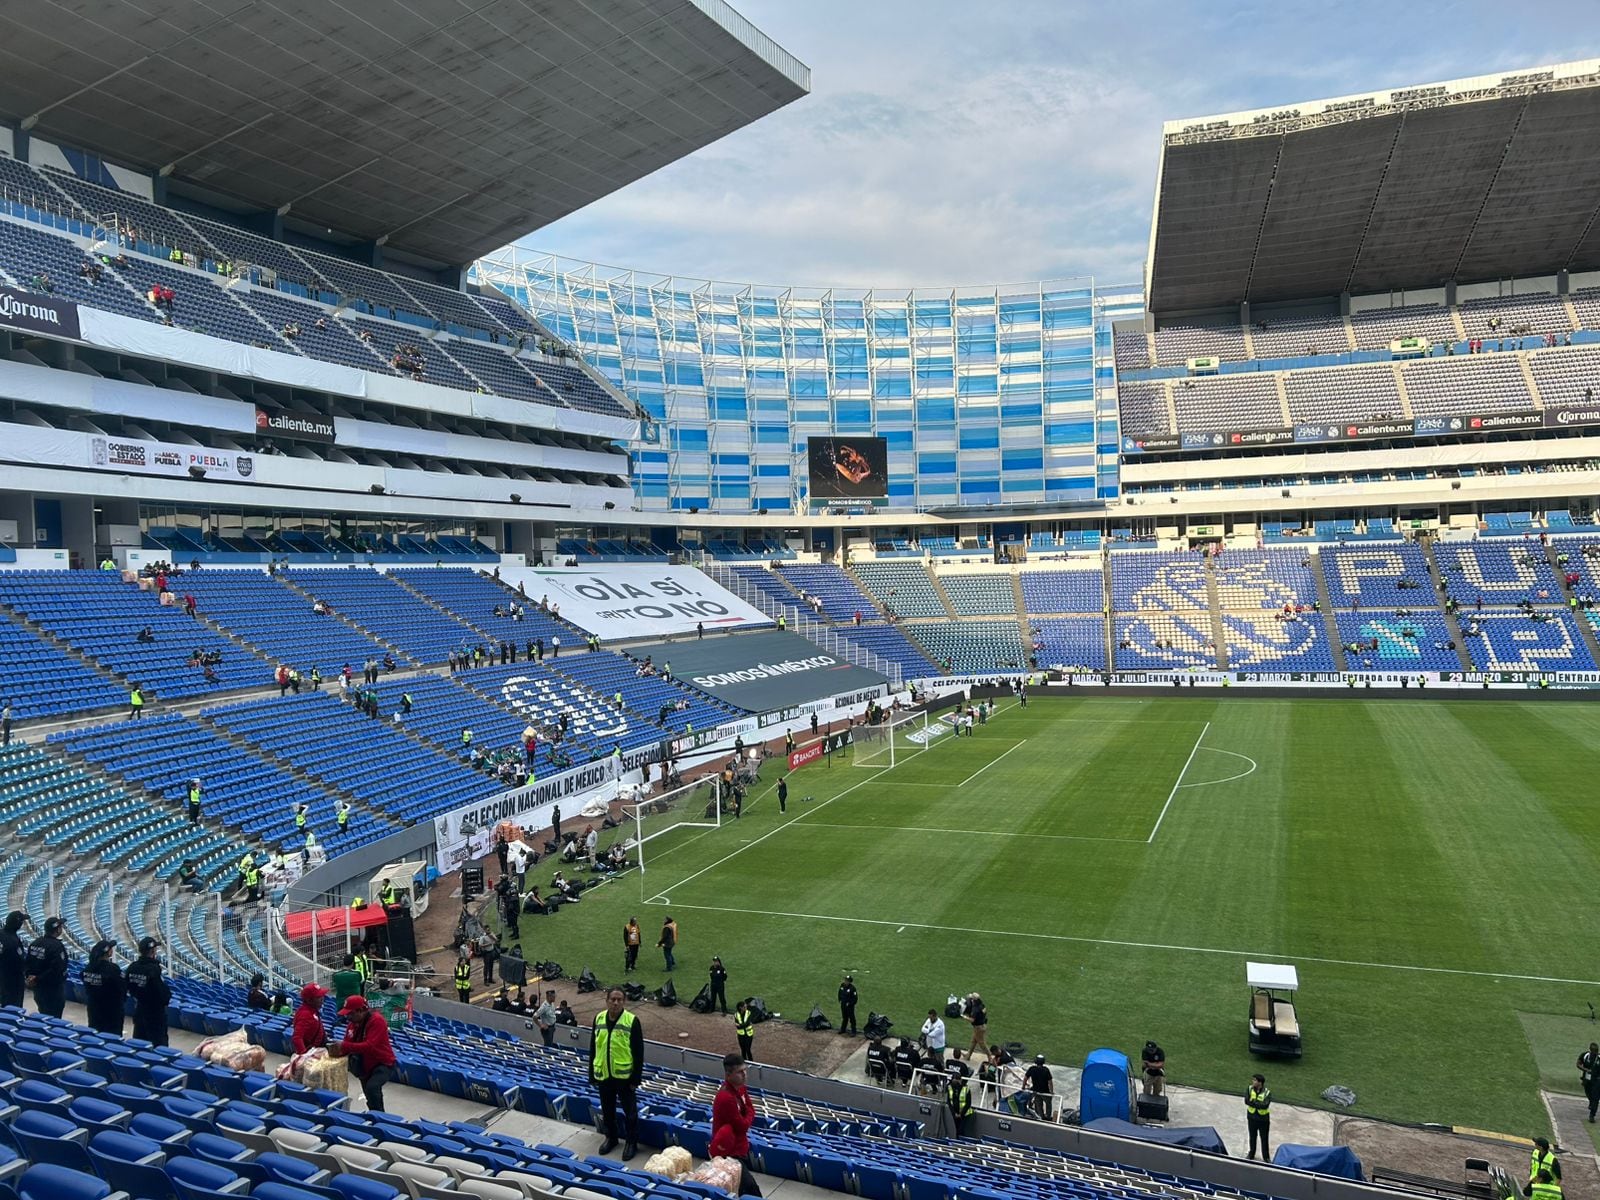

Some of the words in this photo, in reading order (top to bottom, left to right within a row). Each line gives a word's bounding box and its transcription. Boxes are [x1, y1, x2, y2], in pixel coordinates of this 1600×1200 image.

[0, 294, 58, 323] Corona
[1481, 414, 1541, 427] caliente.mx
[1557, 411, 1600, 424] Corona
[268, 415, 333, 436] caliente.mx
[1357, 423, 1413, 435] caliente.mx
[1241, 430, 1293, 443] caliente.mx
[108, 443, 145, 454] GOBIERNO
[117, 451, 145, 461] ESTADO
[154, 457, 182, 466] PUEBLA
[190, 454, 229, 468] PUEBLA
[595, 605, 674, 620] GRITO
[668, 601, 730, 618] NO
[692, 668, 769, 688] SOMOS
[777, 655, 837, 675] MÉXICO
[1245, 673, 1256, 682] 29
[1260, 673, 1291, 682] MARZO
[1300, 673, 1310, 682] 31
[1313, 673, 1339, 682] JULIO
[1449, 673, 1463, 682] 29
[1466, 673, 1502, 682] MARZO
[1511, 673, 1523, 682] 31
[1526, 673, 1555, 682] JULIO
[1559, 674, 1600, 682] ENTRAD
[1072, 674, 1100, 682] MARZO
[1110, 674, 1120, 682] 31
[1122, 674, 1145, 683] JULIO
[856, 692, 863, 703] DE
[863, 687, 881, 701] MÉXICO
[717, 724, 736, 740] ENTRADA
[622, 743, 661, 773] SELECCIÓN
[799, 746, 821, 761] BANORTE
[517, 781, 563, 812] NACIONAL
[564, 774, 574, 795] DE
[575, 766, 605, 792] MÉXICO
